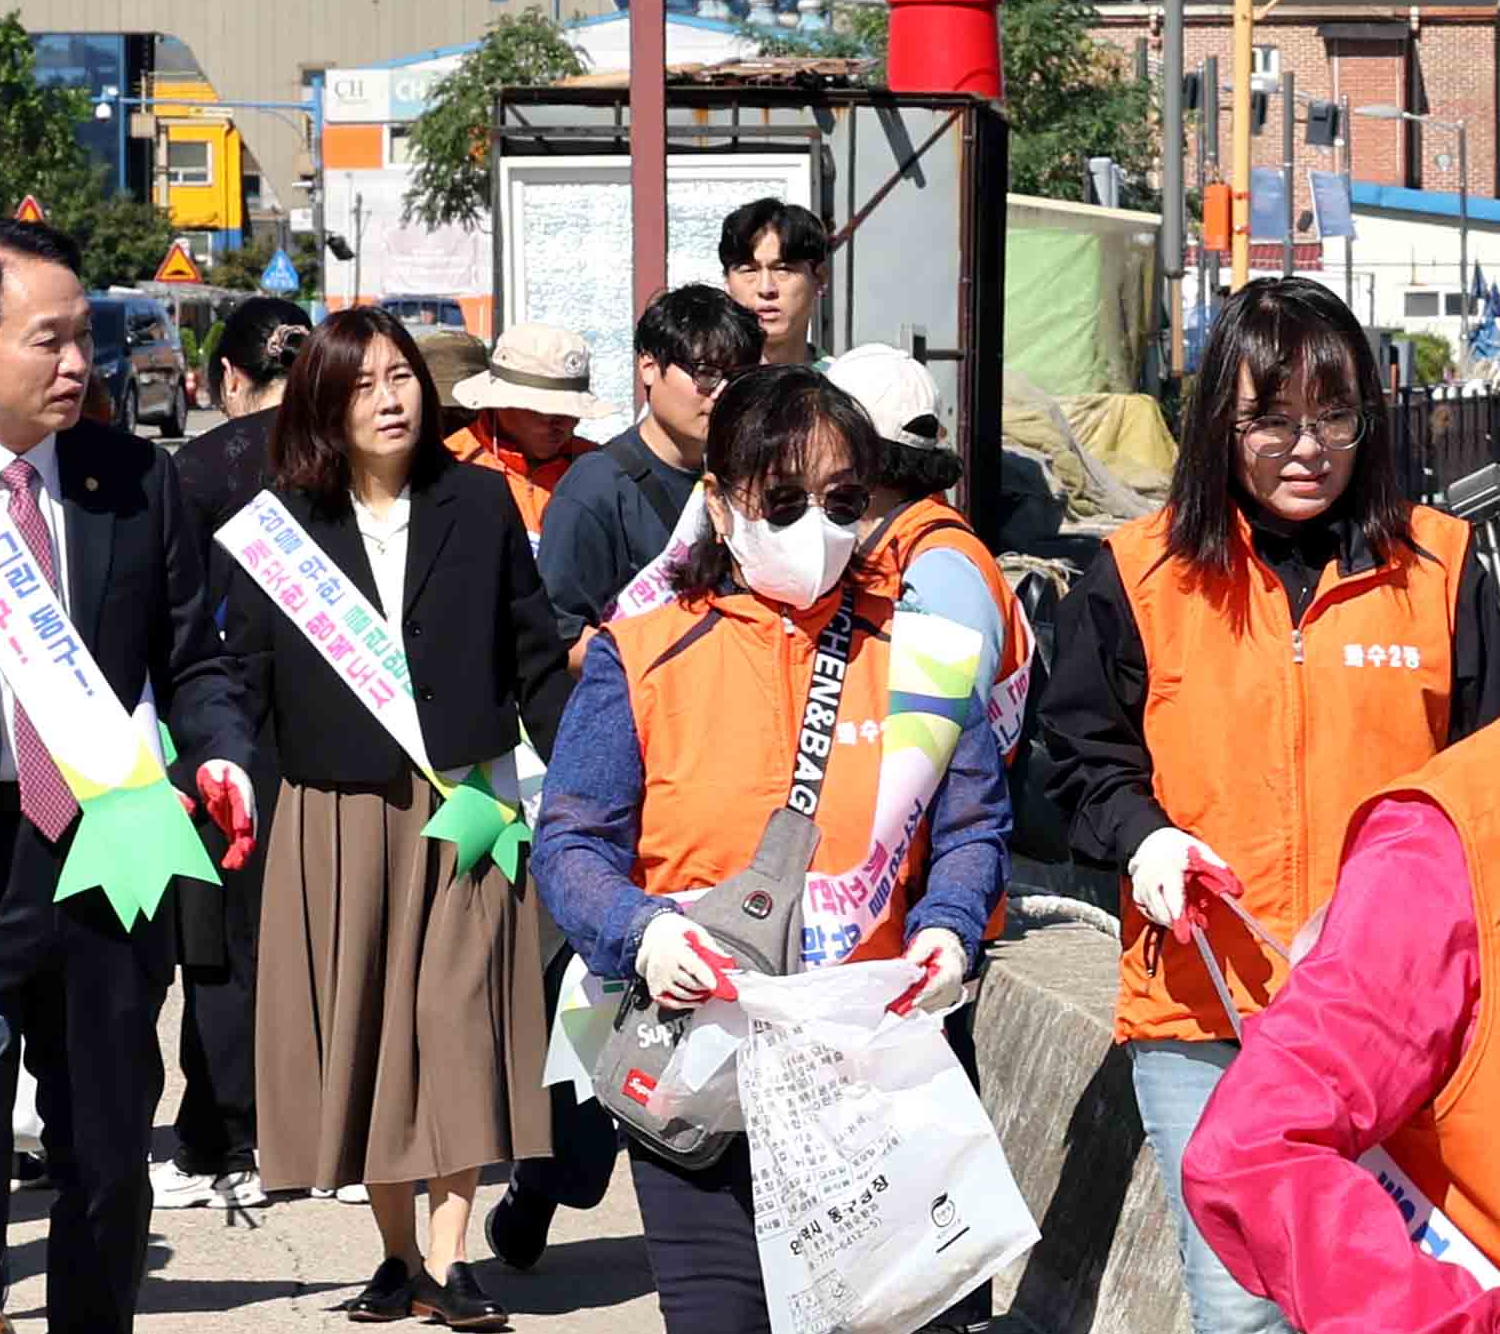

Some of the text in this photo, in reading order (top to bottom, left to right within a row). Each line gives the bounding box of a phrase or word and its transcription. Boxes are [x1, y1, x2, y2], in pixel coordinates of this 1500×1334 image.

[241, 538, 395, 708] 깨끗한 행복도시
[298, 555, 346, 607] 위한
[29, 603, 94, 696] 동구!
